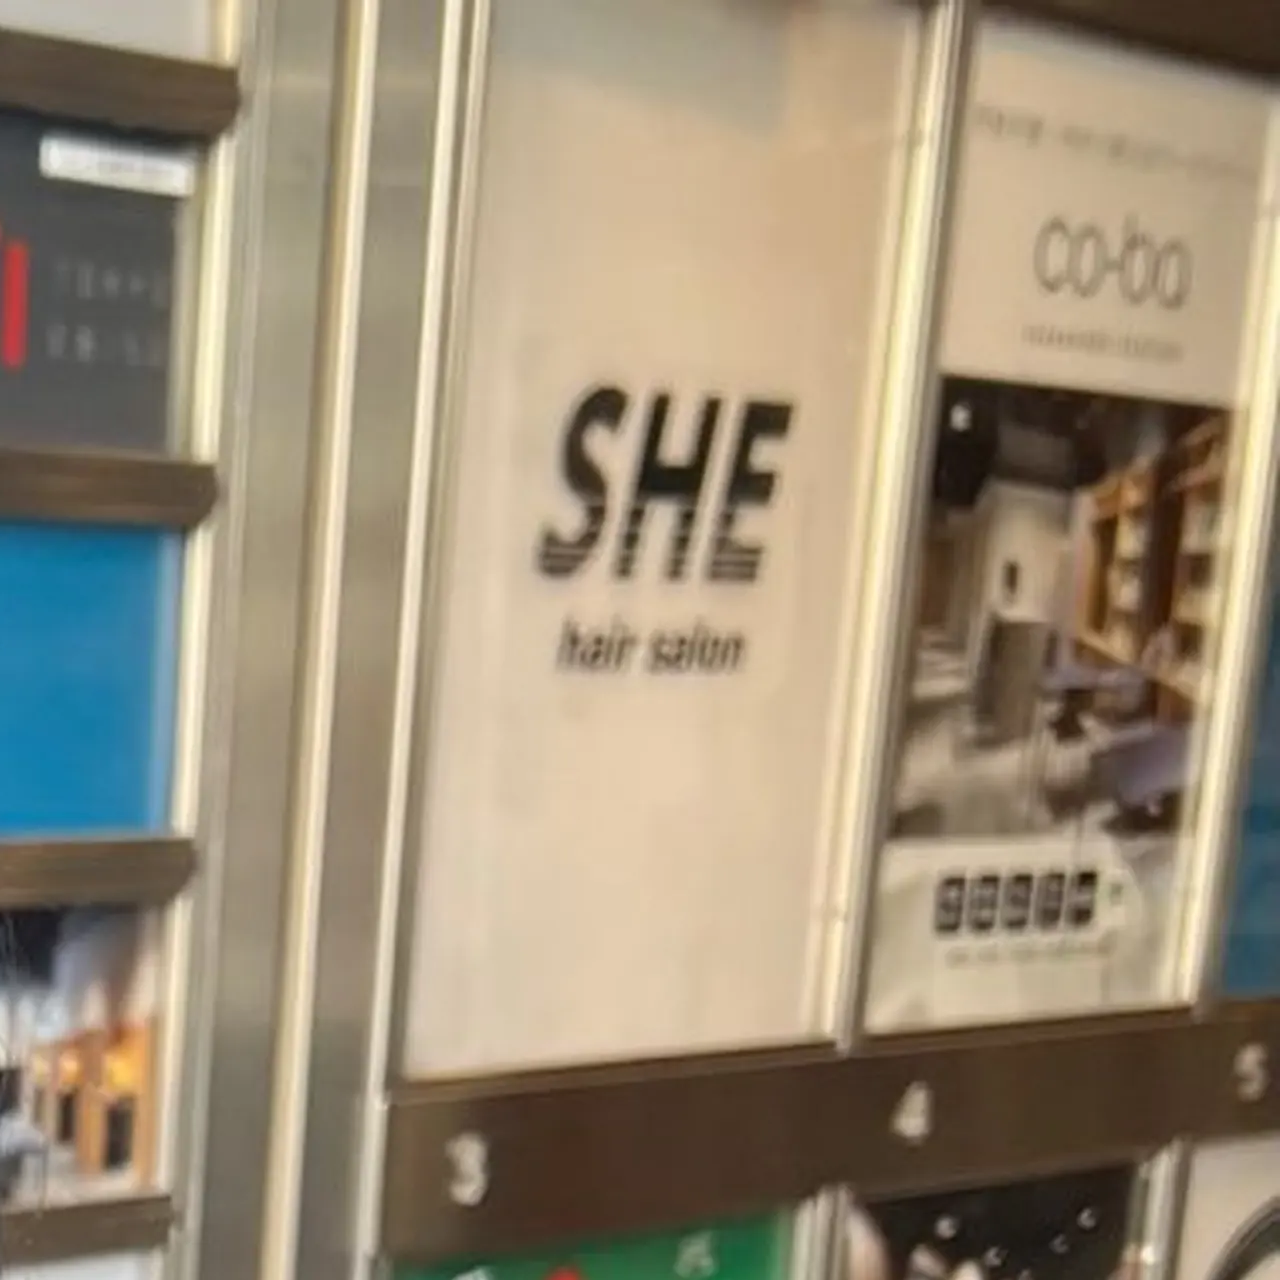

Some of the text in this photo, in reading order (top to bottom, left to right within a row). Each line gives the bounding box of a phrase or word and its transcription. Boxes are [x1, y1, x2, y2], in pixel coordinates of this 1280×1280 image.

[538, 385, 794, 583] SHE
[556, 616, 748, 674] hair salon
[891, 1080, 934, 1144] 4
[445, 1132, 489, 1207] 3
